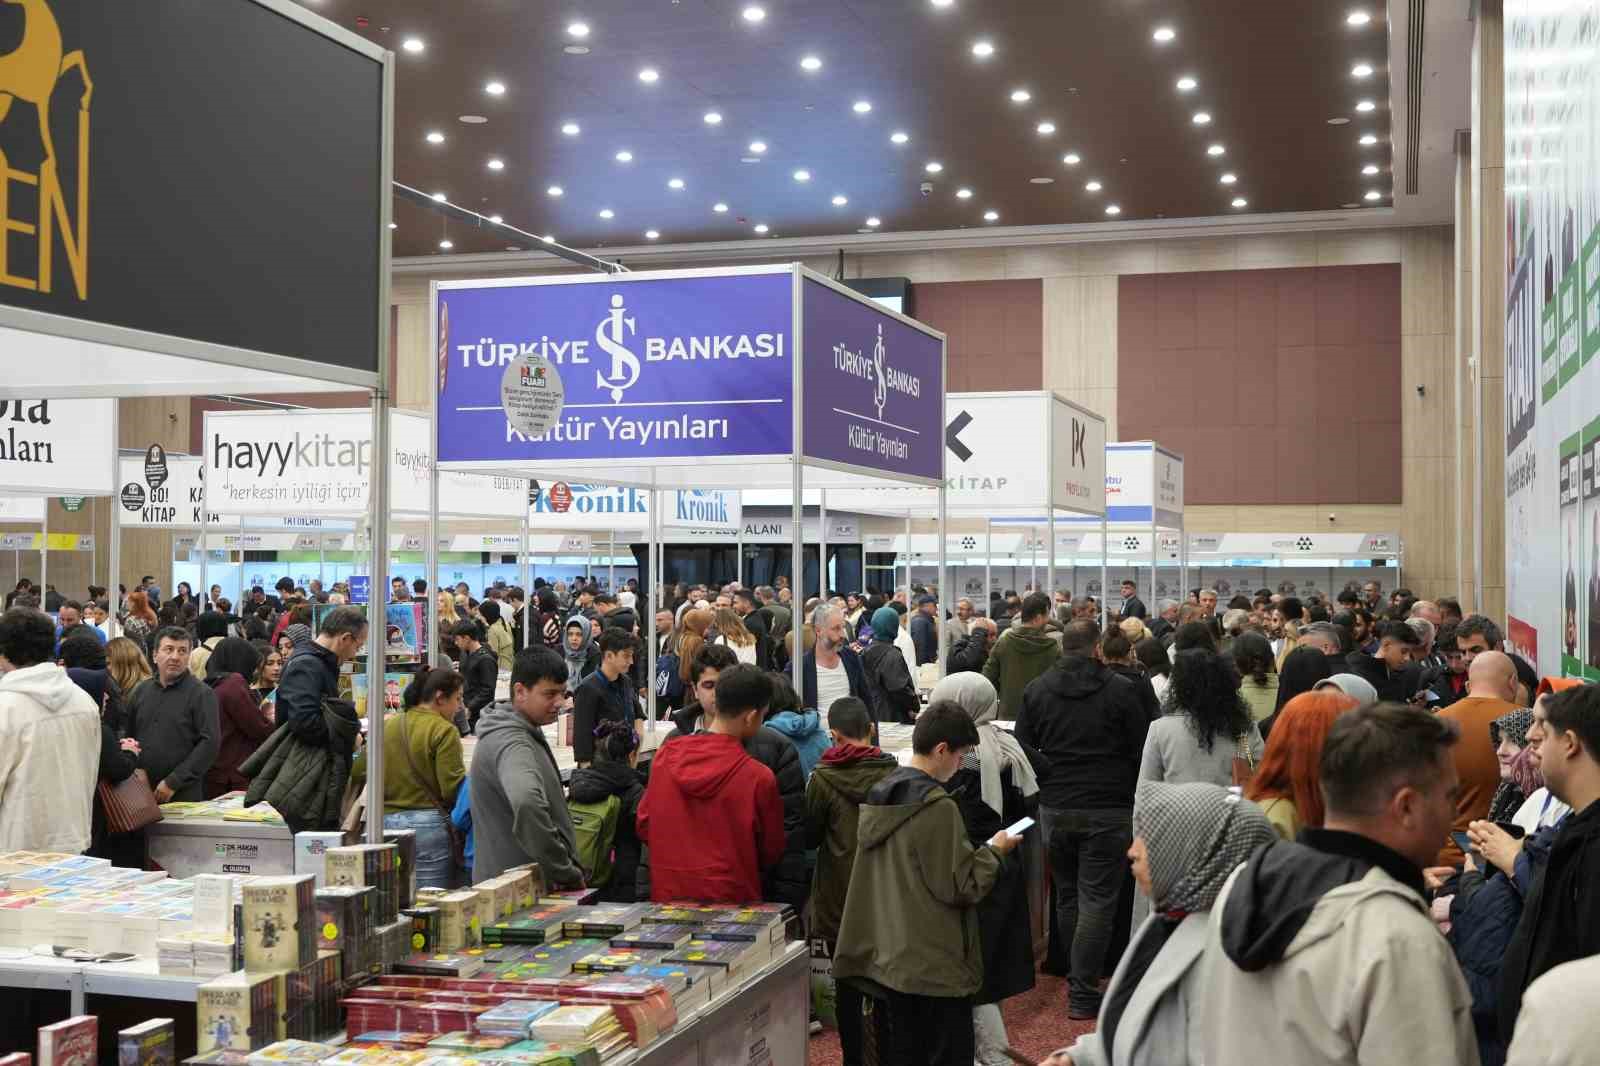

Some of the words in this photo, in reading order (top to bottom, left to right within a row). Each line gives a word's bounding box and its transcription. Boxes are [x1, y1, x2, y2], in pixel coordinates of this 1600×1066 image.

[645, 333, 784, 361] BANKASI
[832, 342, 873, 380] TÜRKİYE
[886, 367, 920, 398] BANKASI
[602, 413, 729, 446] Yayınları
[847, 424, 876, 453] Kültür
[875, 430, 909, 460] Yayınları
[214, 432, 372, 477] hayykitap
[149, 487, 169, 503] GO!
[292, 483, 333, 503] iyiliği
[535, 483, 648, 513] Konik
[945, 476, 1009, 491] KİTAP
[141, 504, 176, 523] KİTAP
[676, 488, 729, 523] Kronik
[744, 524, 783, 536] ALANI
